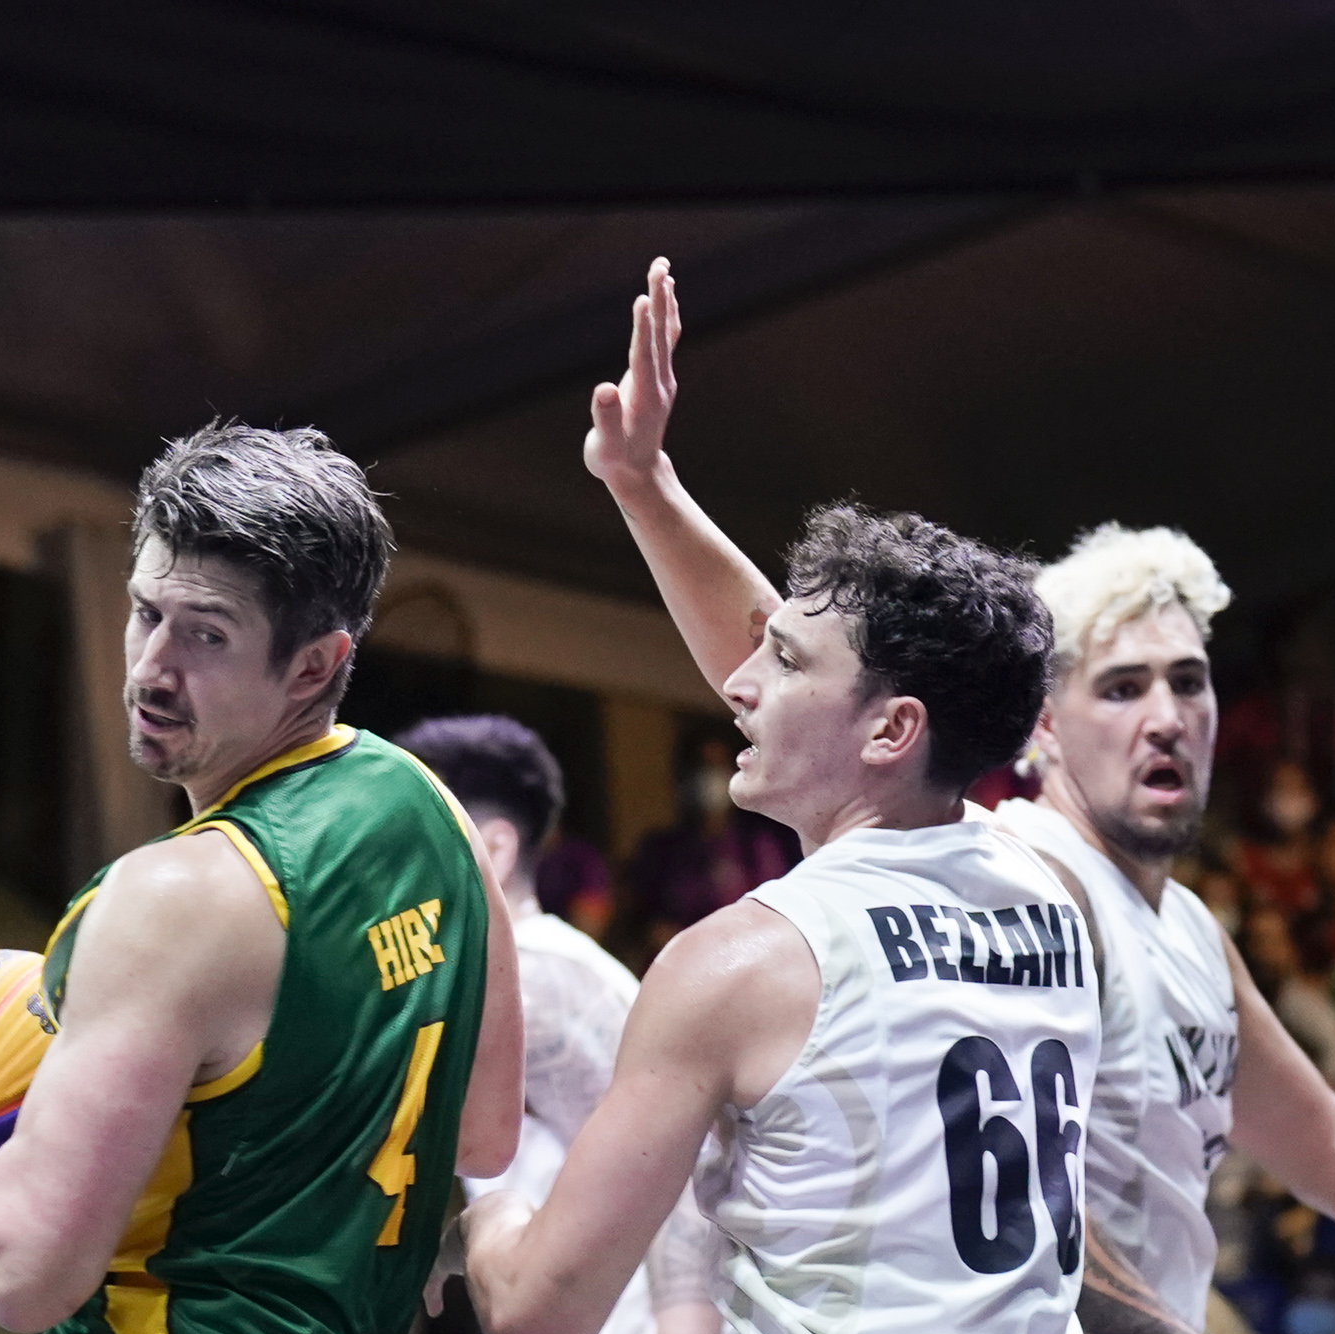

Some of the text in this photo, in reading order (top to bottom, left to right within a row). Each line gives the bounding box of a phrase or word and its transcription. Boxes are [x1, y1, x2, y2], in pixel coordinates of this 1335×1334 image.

[865, 903, 1084, 988] BEZZANT
[368, 1020, 445, 1246] 4
[937, 1035, 1082, 1276] 66
